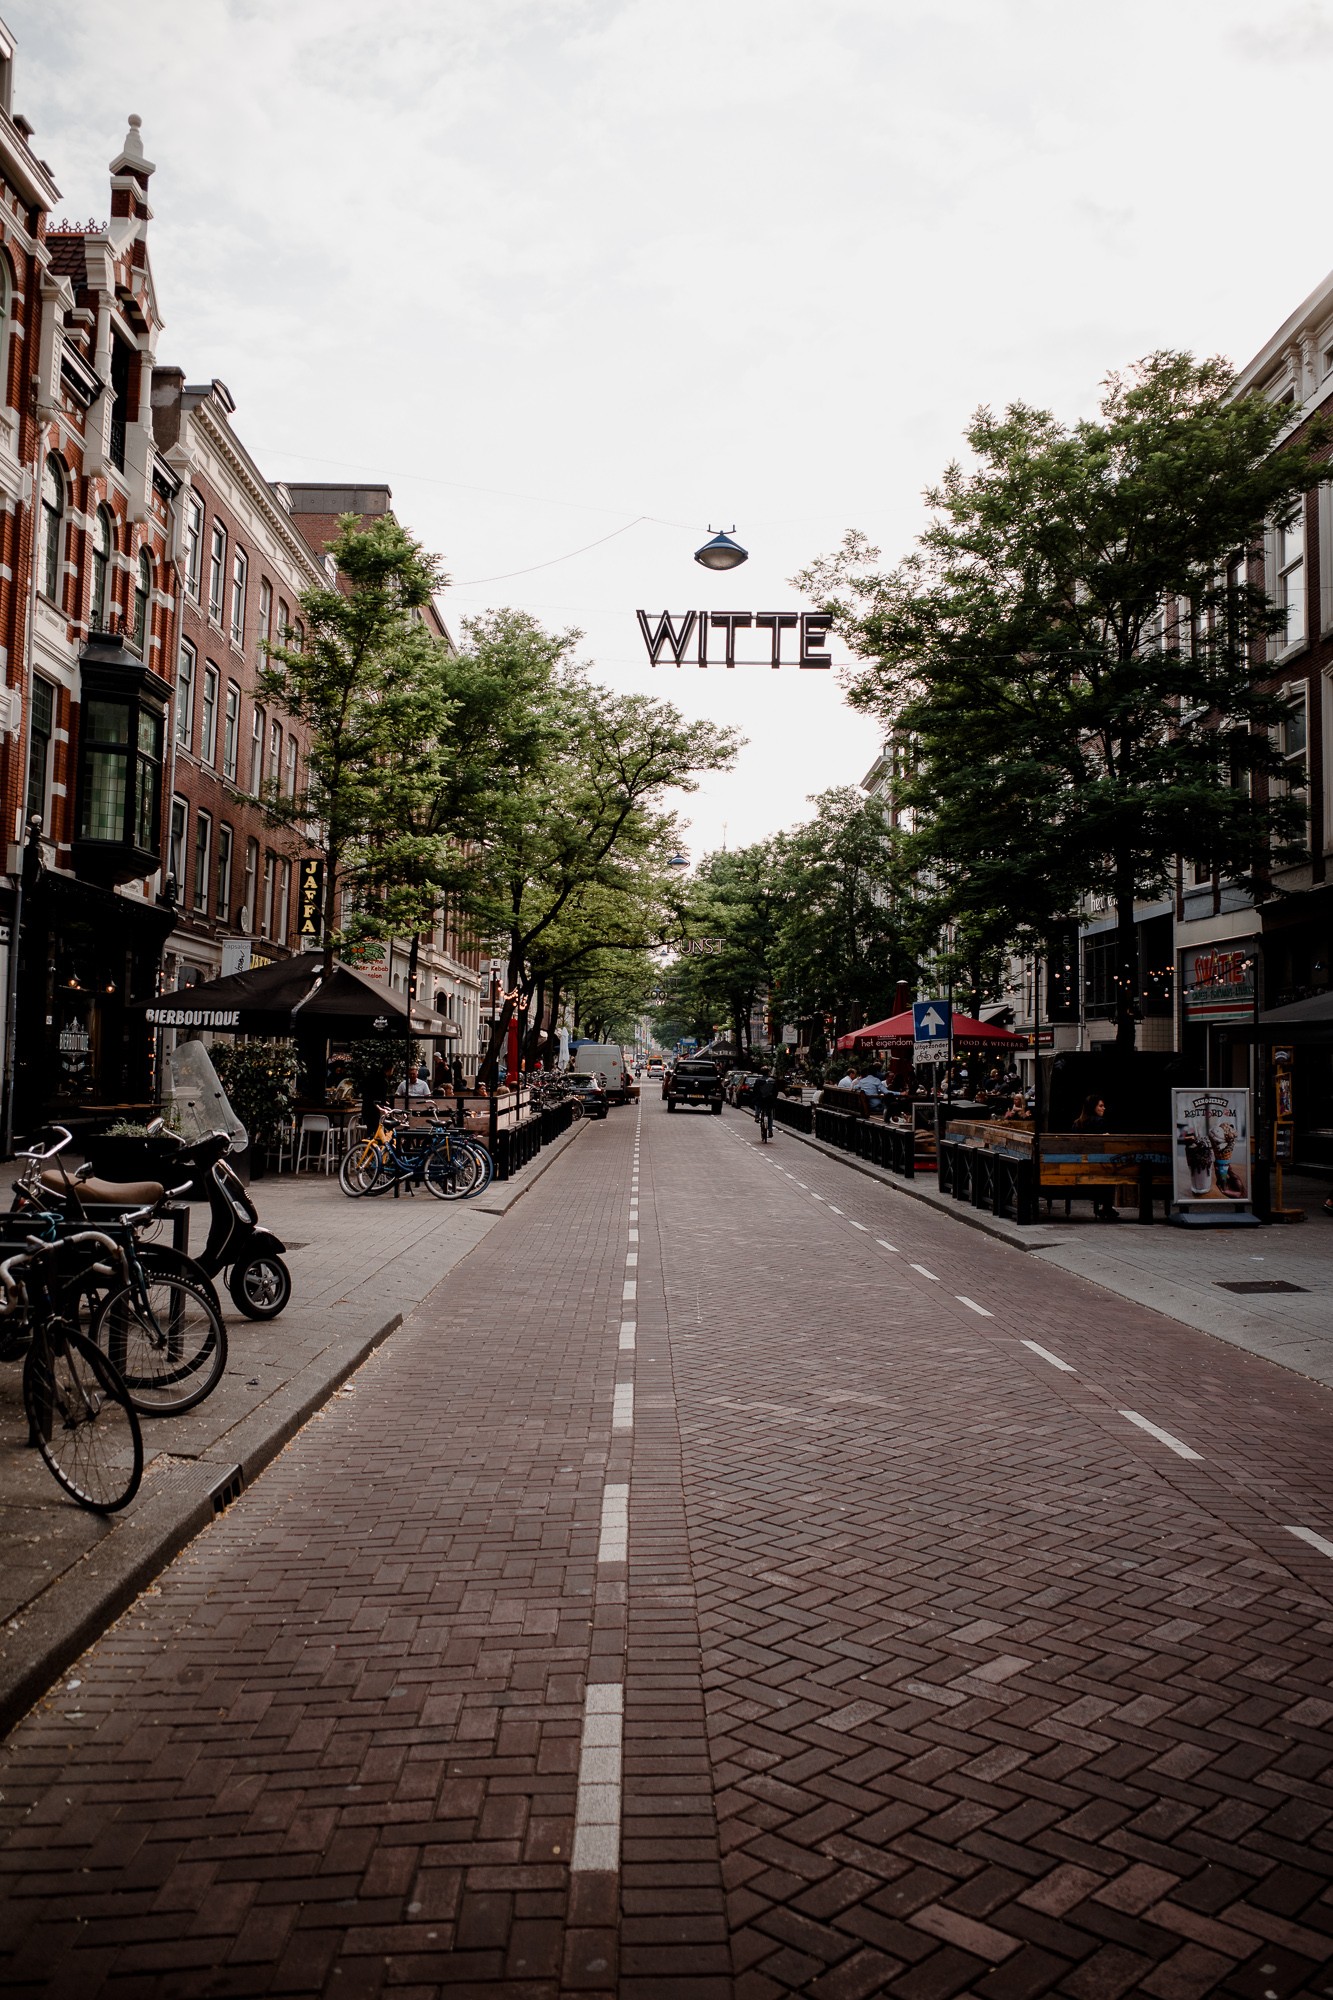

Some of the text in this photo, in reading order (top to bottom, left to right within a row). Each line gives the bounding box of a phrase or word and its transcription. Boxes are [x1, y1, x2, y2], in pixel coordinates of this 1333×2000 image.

[636, 609, 834, 669] WITTE
[301, 861, 318, 933] JAFFA
[667, 938, 727, 955] KUNST
[145, 1008, 240, 1026] BIERBOUTIQUE
[861, 1038, 873, 1047] het
[875, 1037, 913, 1048] eigendom
[914, 1043, 949, 1051] uitgezonder
[991, 1040, 1024, 1048] WINEBAR
